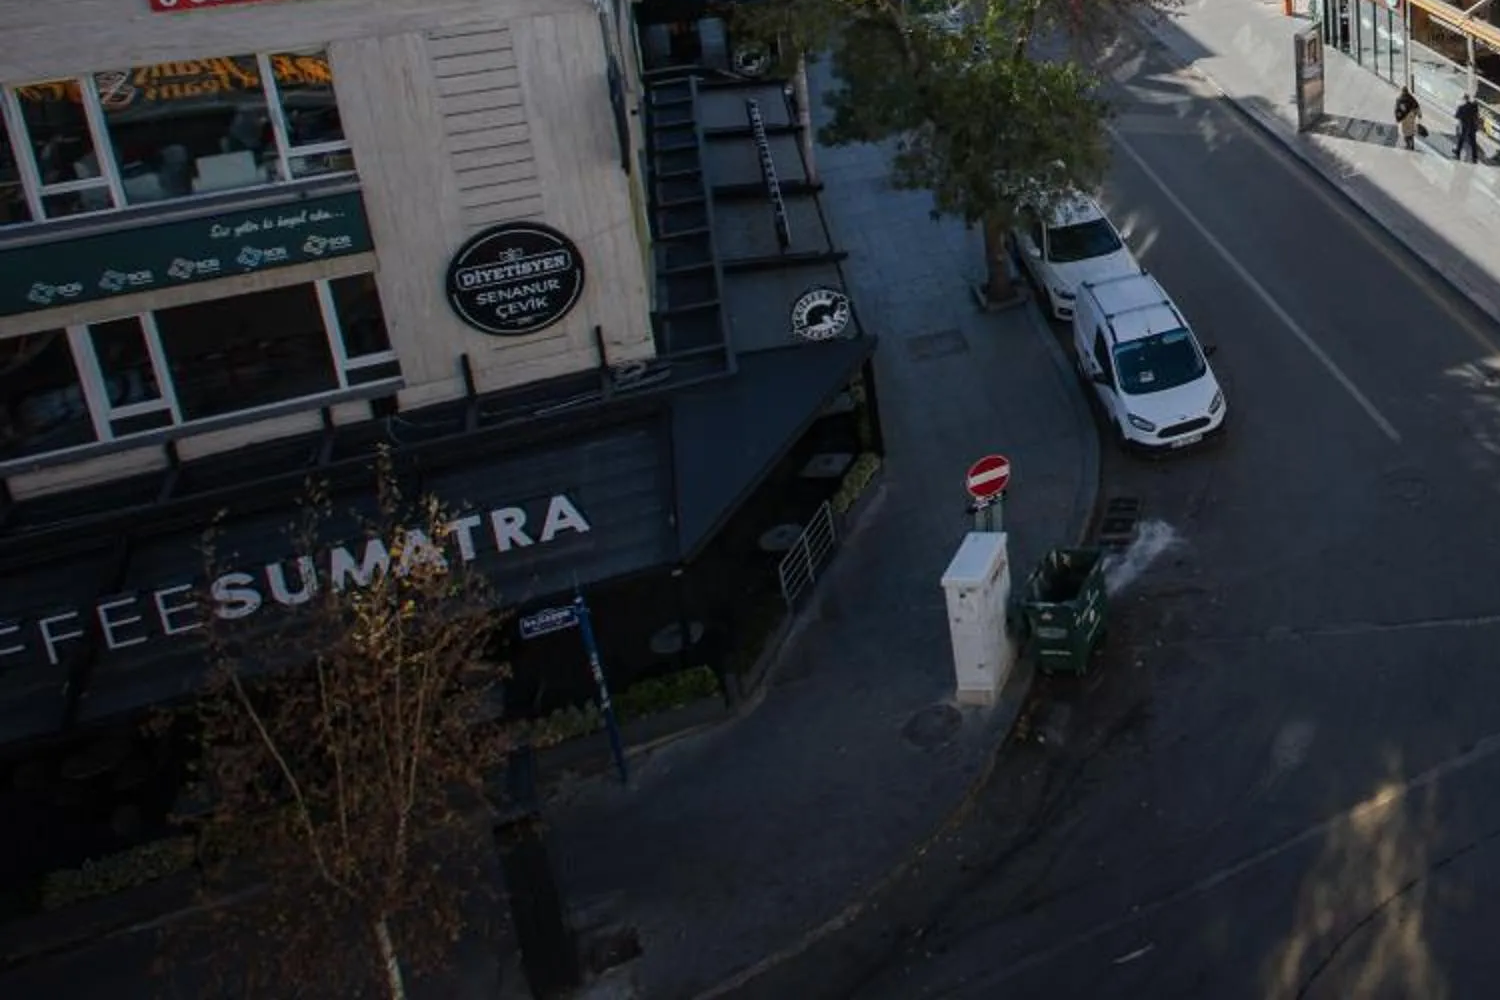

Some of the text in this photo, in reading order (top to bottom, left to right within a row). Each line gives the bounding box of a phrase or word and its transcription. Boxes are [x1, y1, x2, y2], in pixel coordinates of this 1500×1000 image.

[476, 279, 561, 305] SENANUR
[495, 296, 549, 319] ÇEVİK
[211, 494, 591, 620] SUMATRA
